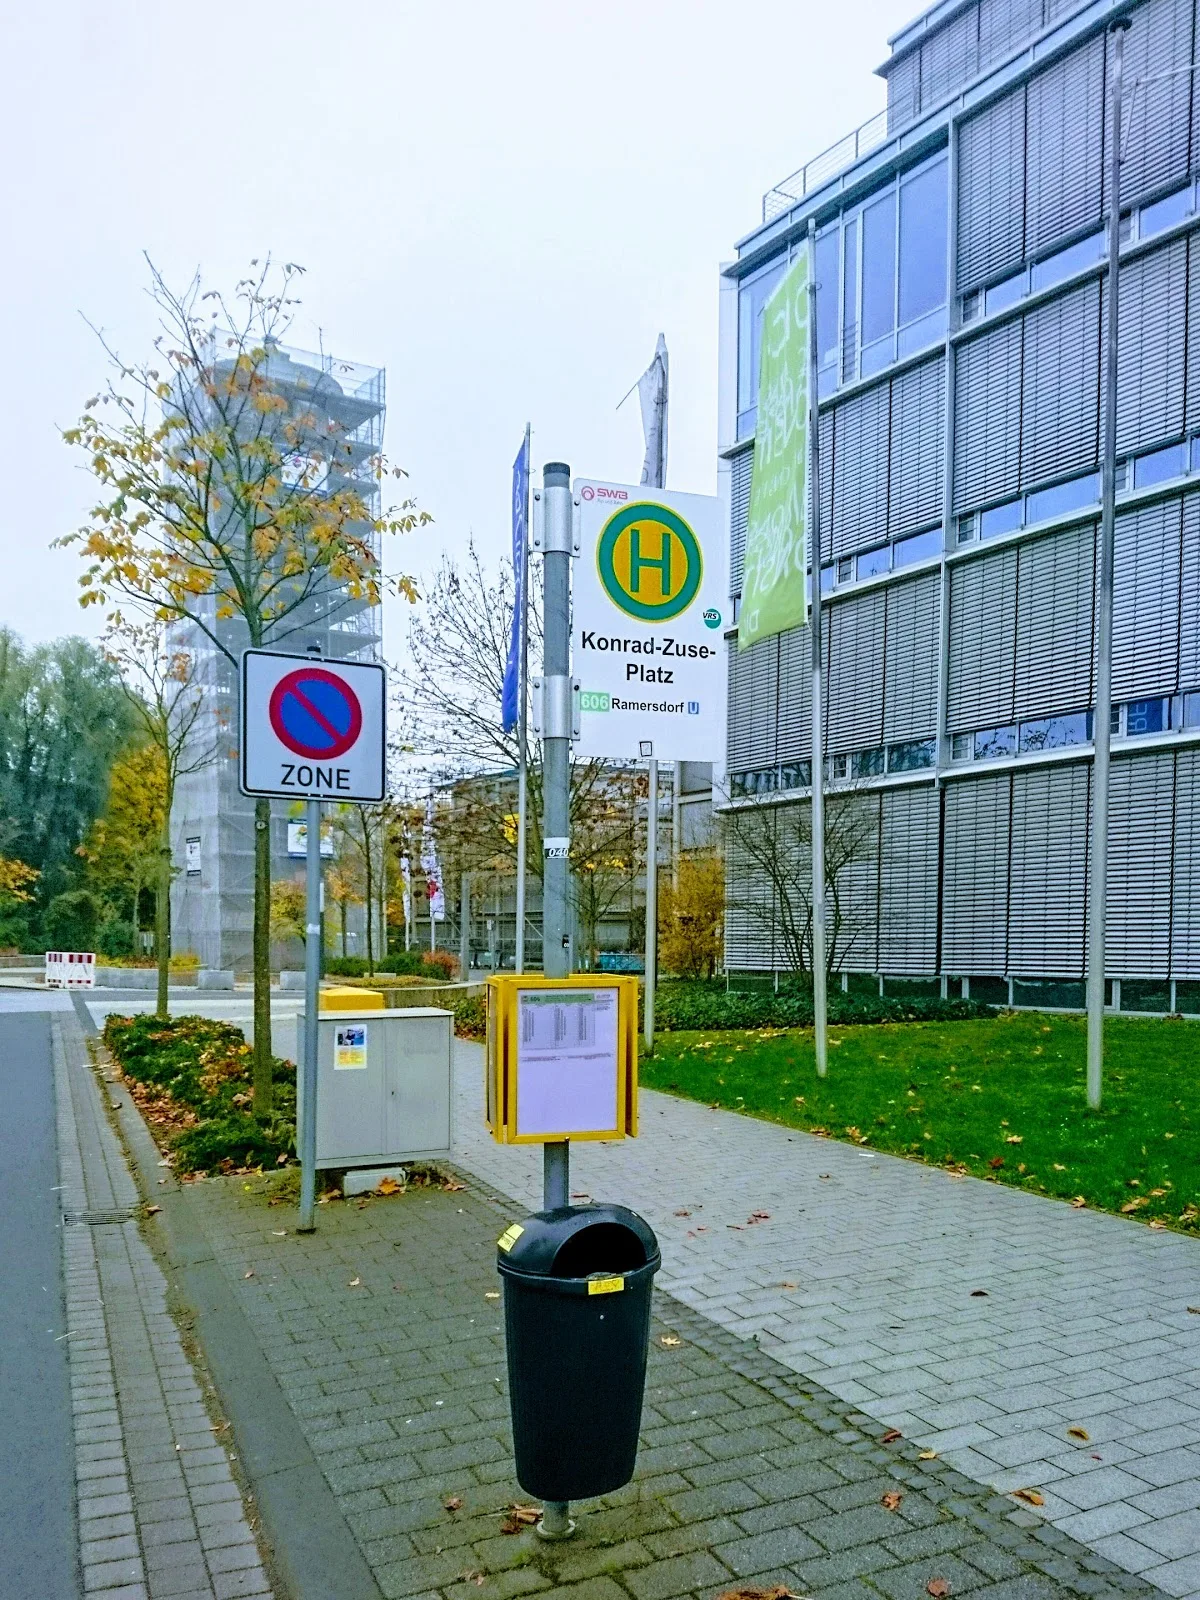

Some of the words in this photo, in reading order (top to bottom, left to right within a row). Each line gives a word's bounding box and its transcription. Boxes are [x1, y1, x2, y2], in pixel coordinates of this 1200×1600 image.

[597, 488, 628, 500] SWB
[630, 528, 671, 596] H
[702, 611, 717, 620] VRS
[582, 631, 716, 659] Konrad-Zuse-
[626, 664, 674, 684] Platz
[581, 694, 609, 711] 606
[611, 697, 684, 713] Ramersdorf
[689, 702, 698, 713] U
[281, 764, 351, 790] ZONE
[549, 848, 569, 857] 040
